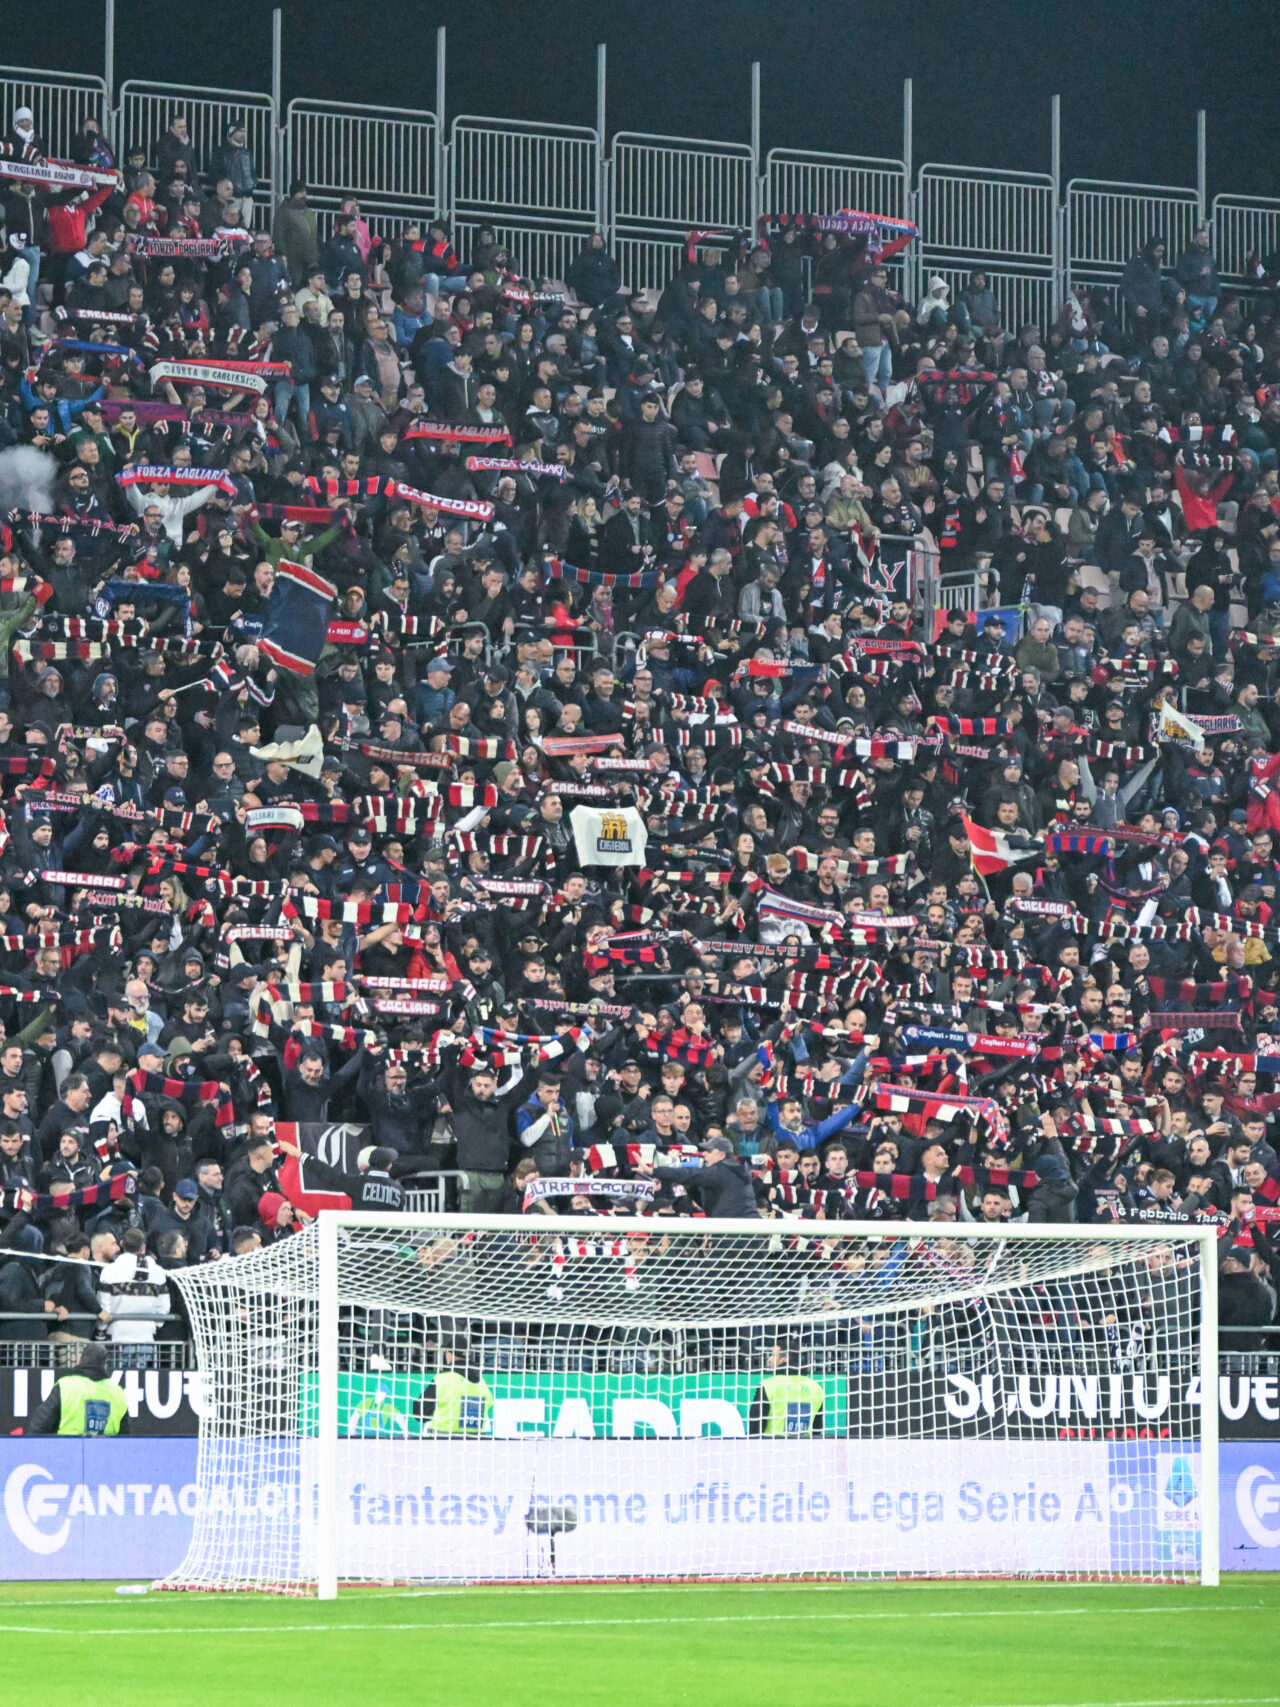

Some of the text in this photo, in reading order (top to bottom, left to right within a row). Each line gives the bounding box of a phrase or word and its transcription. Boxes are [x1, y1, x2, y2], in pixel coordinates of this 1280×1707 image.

[419, 420, 503, 438] FORZA CAGLIARI
[474, 457, 516, 469] FORZA
[136, 466, 223, 484] FORZA CAGLIARI
[397, 483, 492, 517] CASTEDDU
[778, 667, 793, 676] 1920
[369, 745, 449, 768] CAGLIARI
[598, 758, 651, 771] CAGLIARI
[550, 781, 607, 795] CAGLIARI
[47, 871, 121, 888] CAGLIARI
[482, 879, 540, 894] CAGLIARI
[1018, 900, 1068, 914] CAGLIARI
[855, 914, 913, 927] CAGLIARI
[228, 927, 290, 940] CAGLIARI
[367, 976, 448, 990] CAGLIARI
[378, 1000, 436, 1014] CAGLIARI
[918, 1029, 1026, 1050] Cagliari 1920 Cagliari 1920
[362, 1182, 401, 1208] CELTICS
[1118, 1207, 1127, 1217] 6
[1130, 1207, 1189, 1221] Febbraio
[349, 1483, 514, 1536] fantasy
[664, 1481, 831, 1525] ufficiale
[848, 1480, 945, 1532] Lega
[957, 1480, 1062, 1523] Serie
[1074, 1481, 1104, 1523] A
